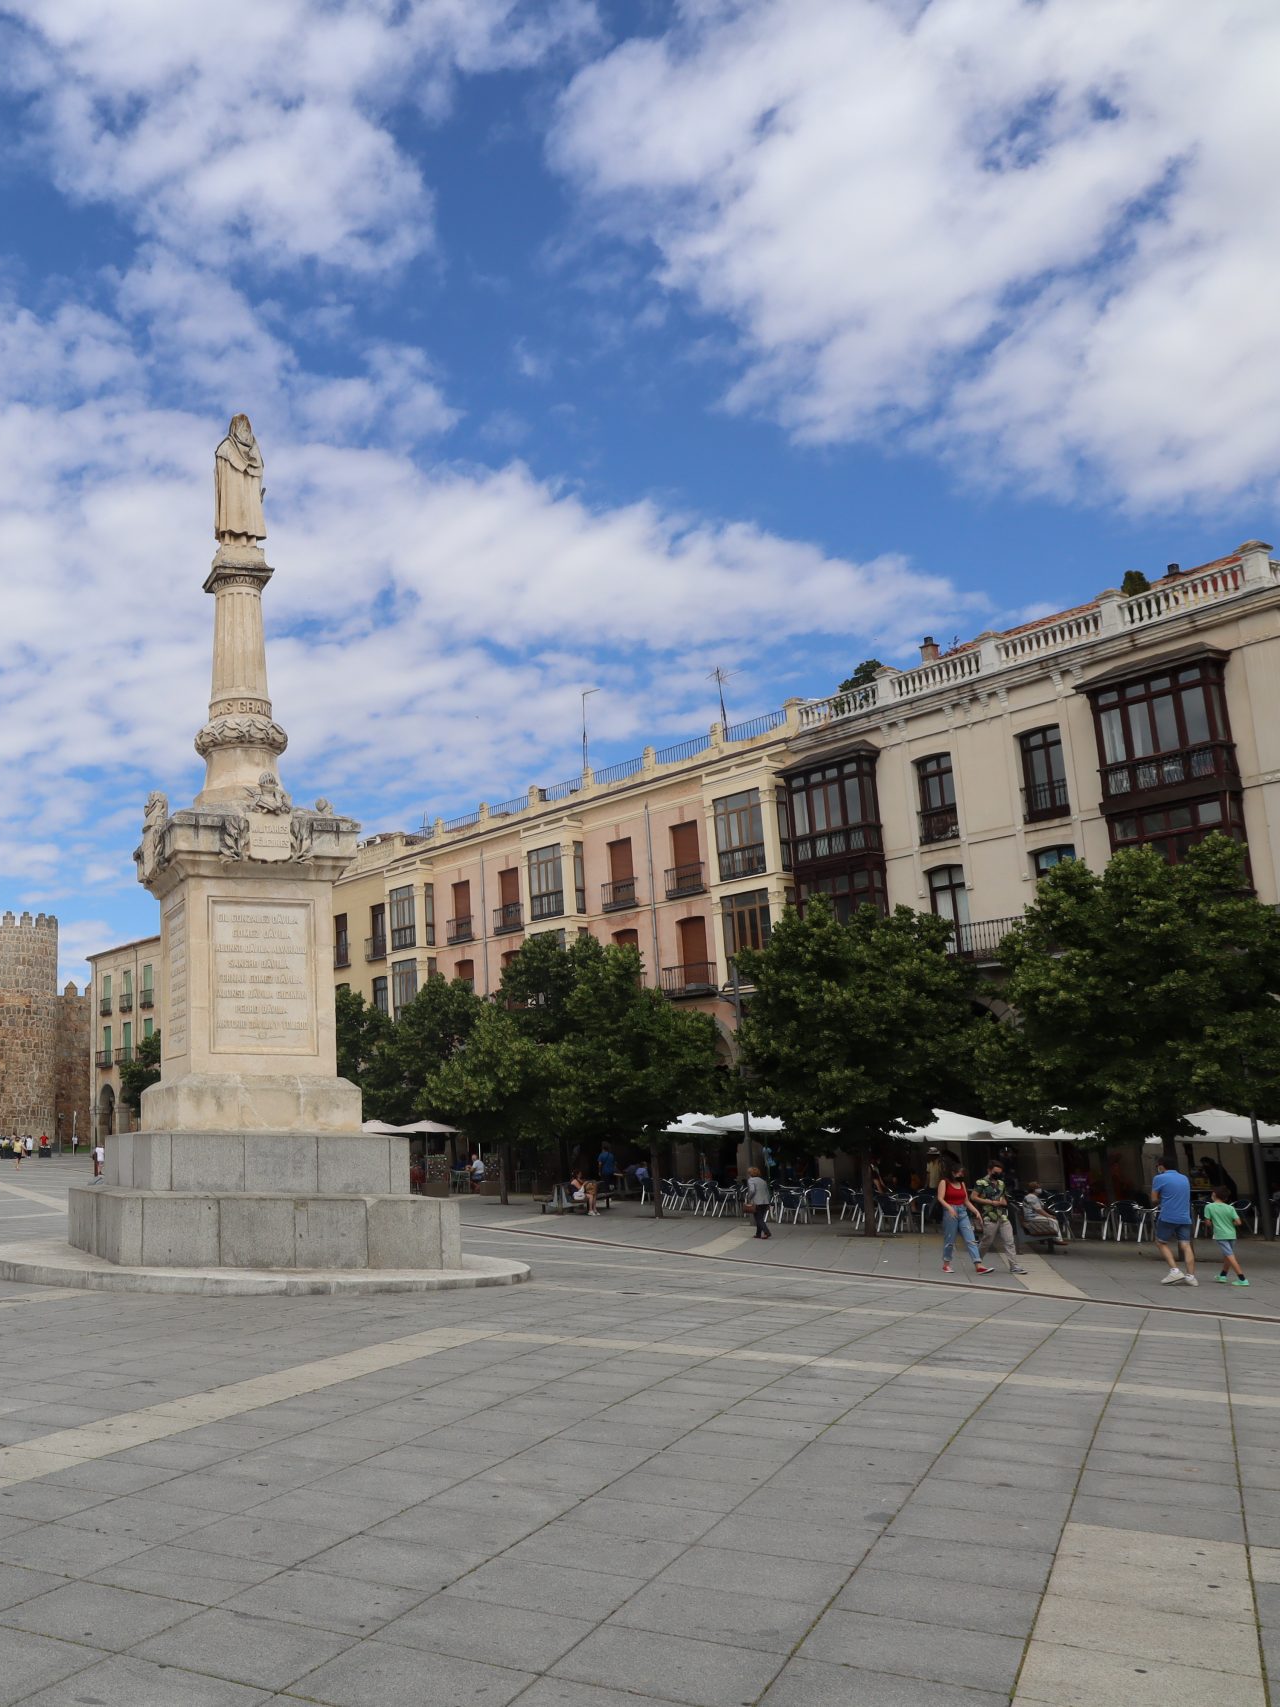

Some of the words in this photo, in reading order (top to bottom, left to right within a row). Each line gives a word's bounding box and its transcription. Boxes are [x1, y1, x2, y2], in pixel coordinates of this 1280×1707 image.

[211, 700, 233, 718] LAS
[250, 823, 289, 835] MILITARES
[217, 913, 229, 923] GIL
[215, 943, 243, 953] ALONSO
[227, 959, 259, 969] SANCHO
[234, 1004, 259, 1014] PEDRO
